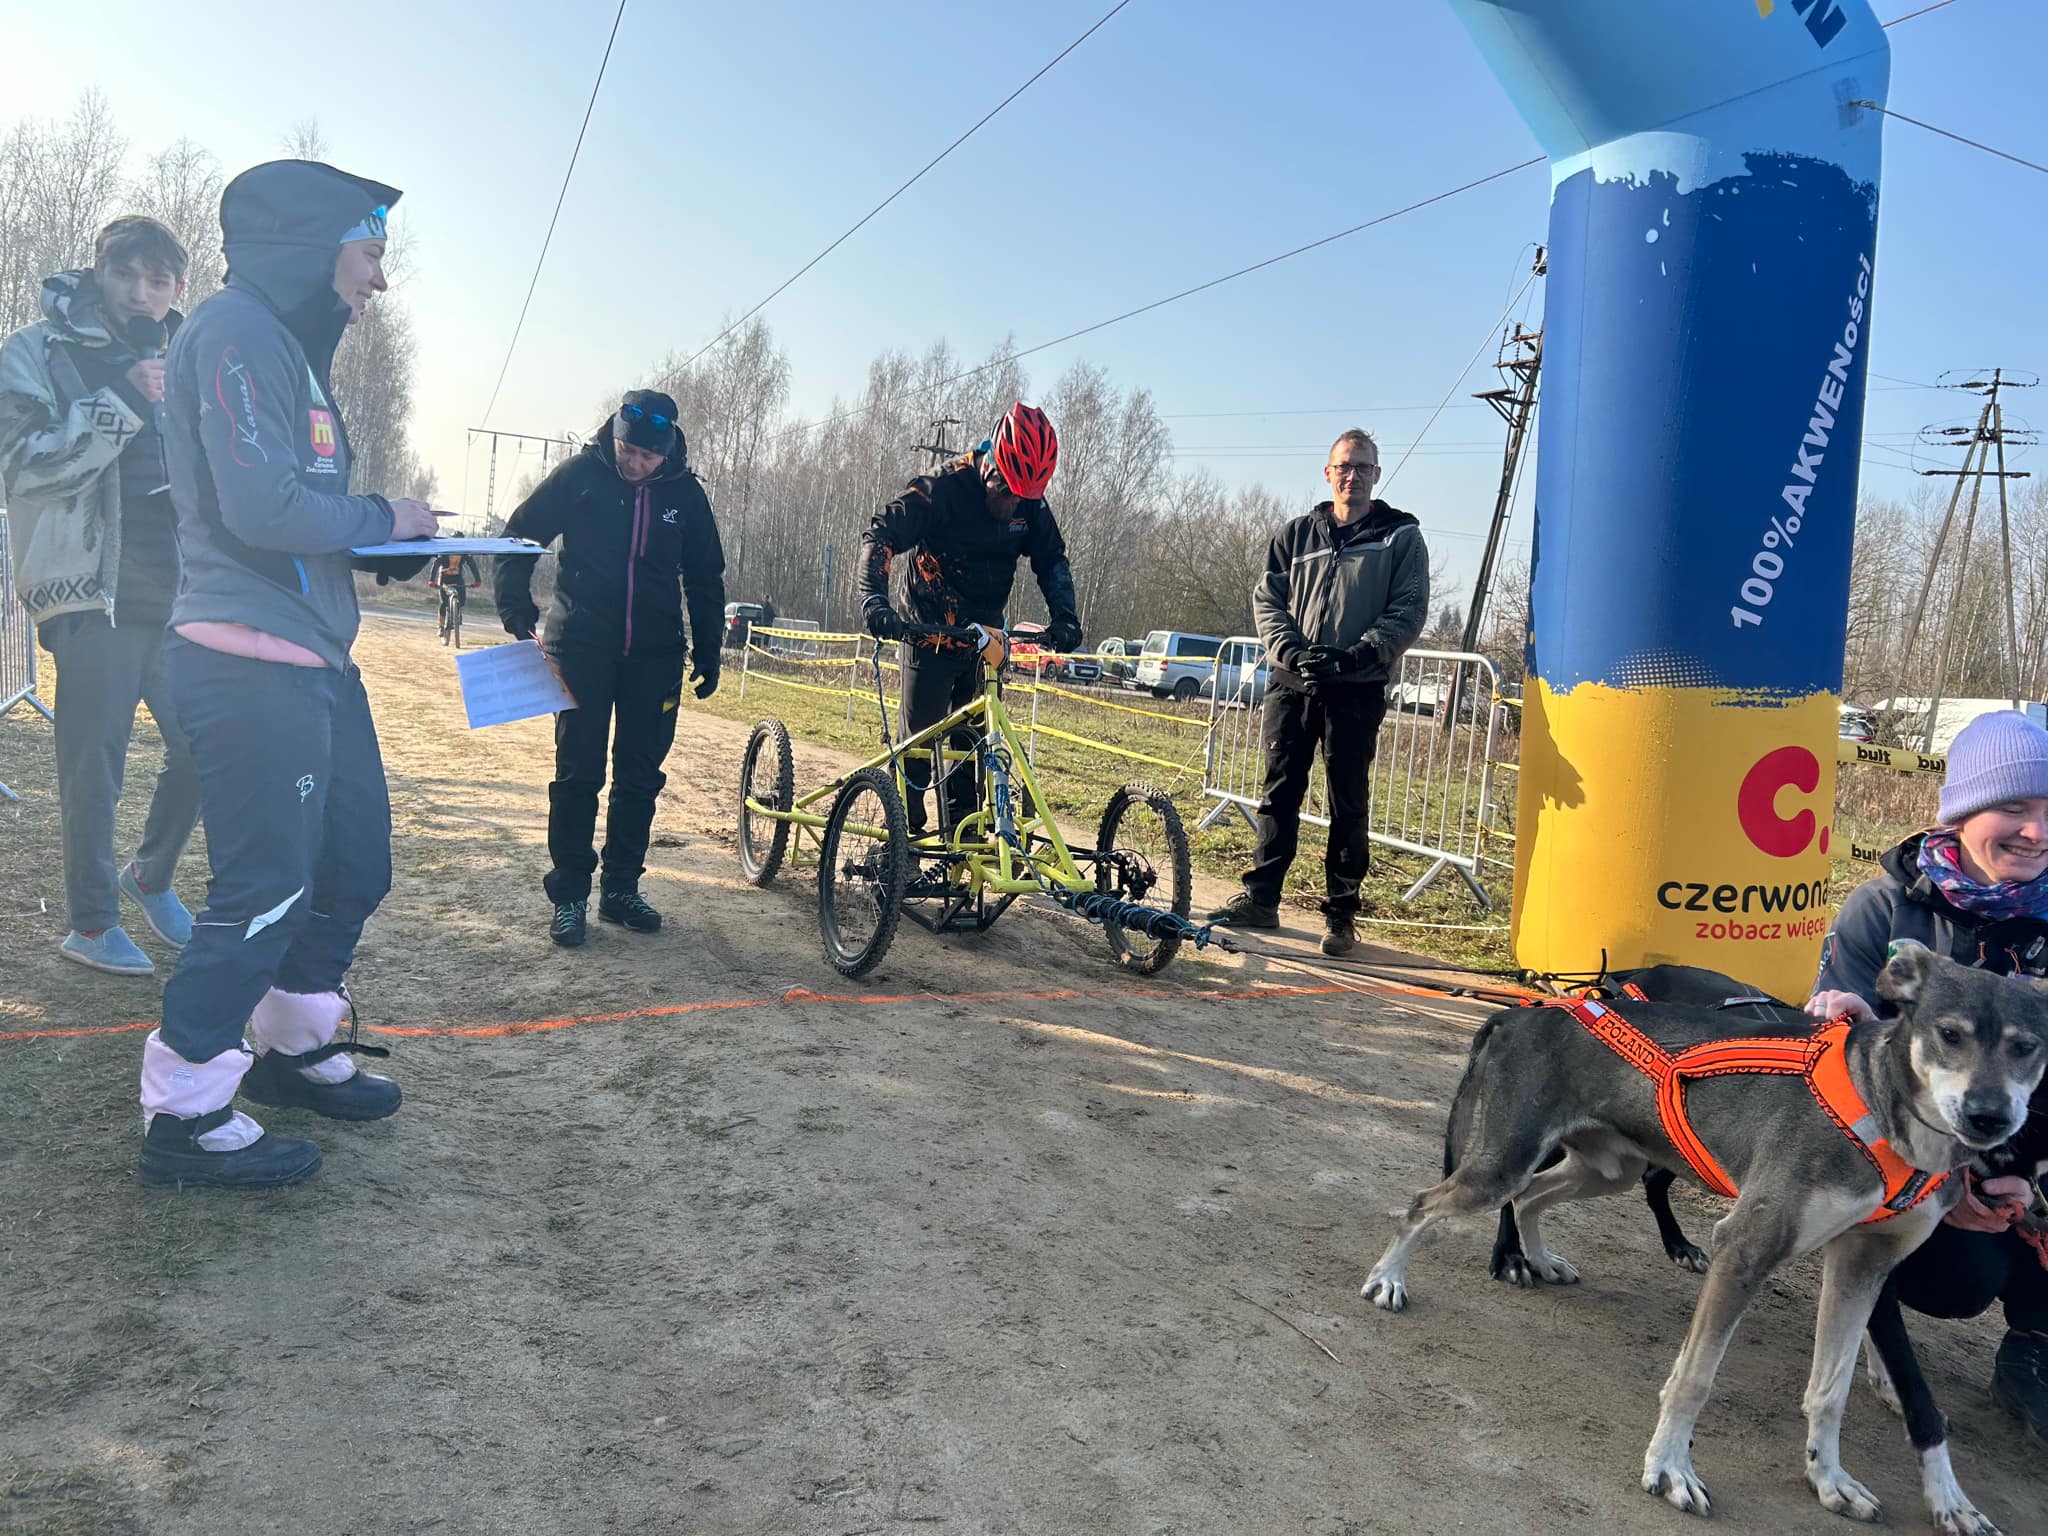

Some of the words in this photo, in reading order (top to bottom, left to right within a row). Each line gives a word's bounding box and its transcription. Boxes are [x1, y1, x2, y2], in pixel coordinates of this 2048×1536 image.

[1856, 745, 1891, 764] bult
[1917, 755, 1947, 771] bul
[1695, 919, 1782, 940] zobacz
[1601, 1018, 1655, 1065] POLAND
